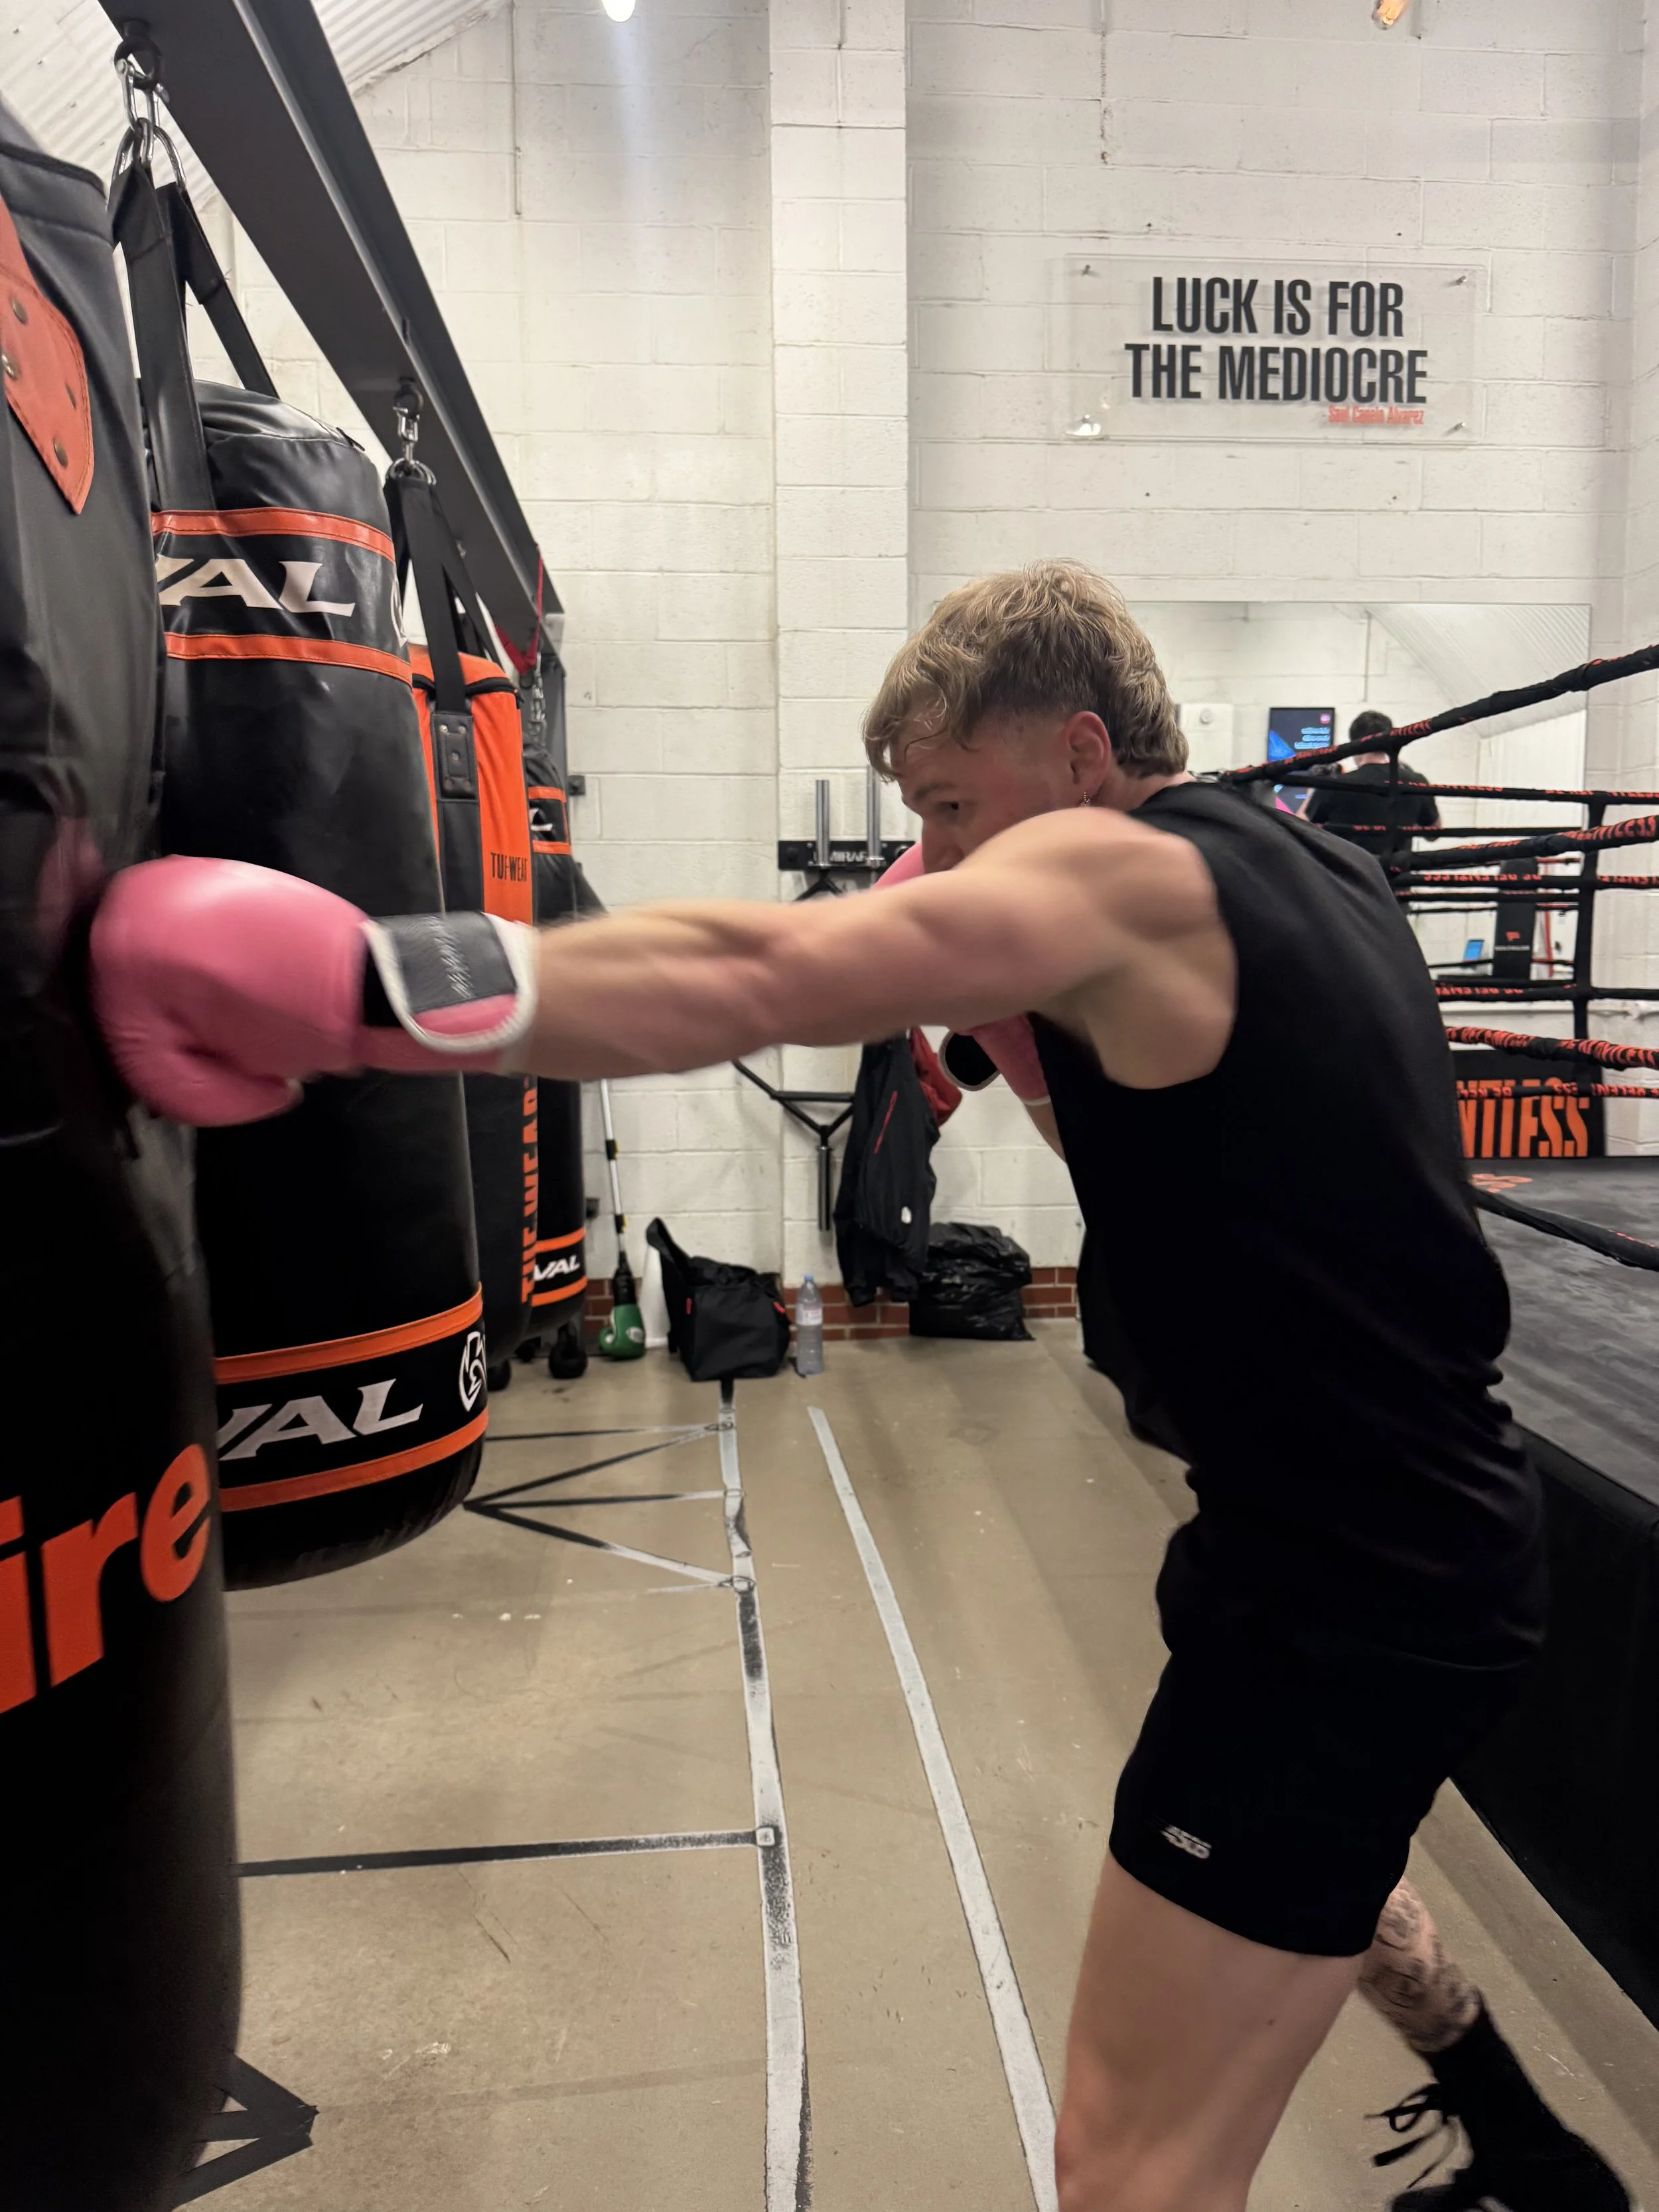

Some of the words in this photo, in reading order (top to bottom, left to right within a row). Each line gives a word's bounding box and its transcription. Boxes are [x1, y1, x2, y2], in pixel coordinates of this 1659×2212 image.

[1152, 277, 1258, 334] LUCK
[1273, 279, 1311, 336] IS
[1328, 281, 1404, 337] FOR
[1125, 343, 1202, 399] THE
[1219, 346, 1427, 404] MEDIOCRE
[533, 1254, 581, 1281] VAL
